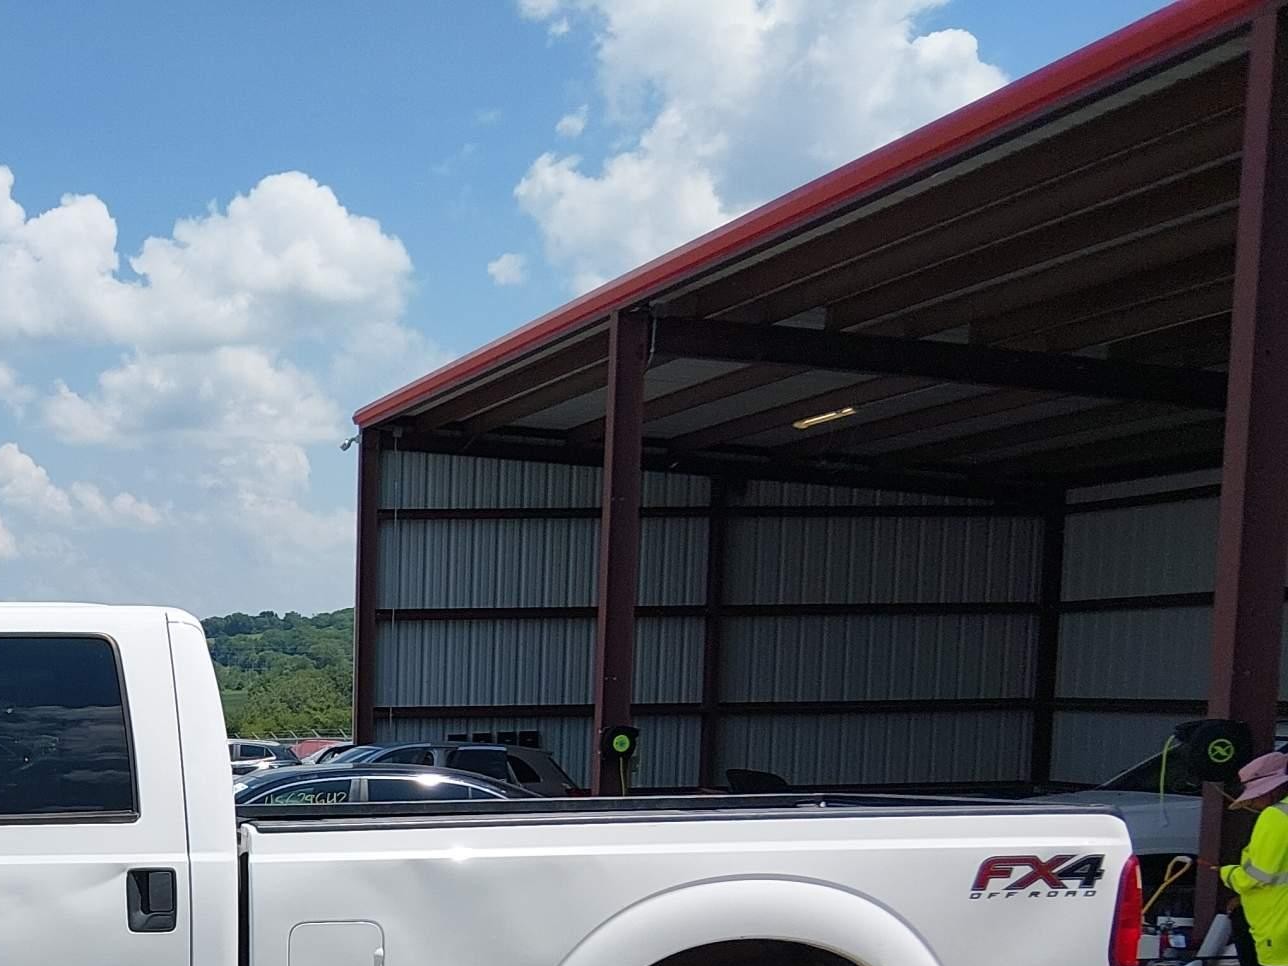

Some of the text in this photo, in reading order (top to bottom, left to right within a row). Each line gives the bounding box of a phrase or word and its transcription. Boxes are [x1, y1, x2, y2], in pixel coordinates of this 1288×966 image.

[970, 853, 1106, 892] FX4
[968, 889, 1097, 900] OFF ROAD
